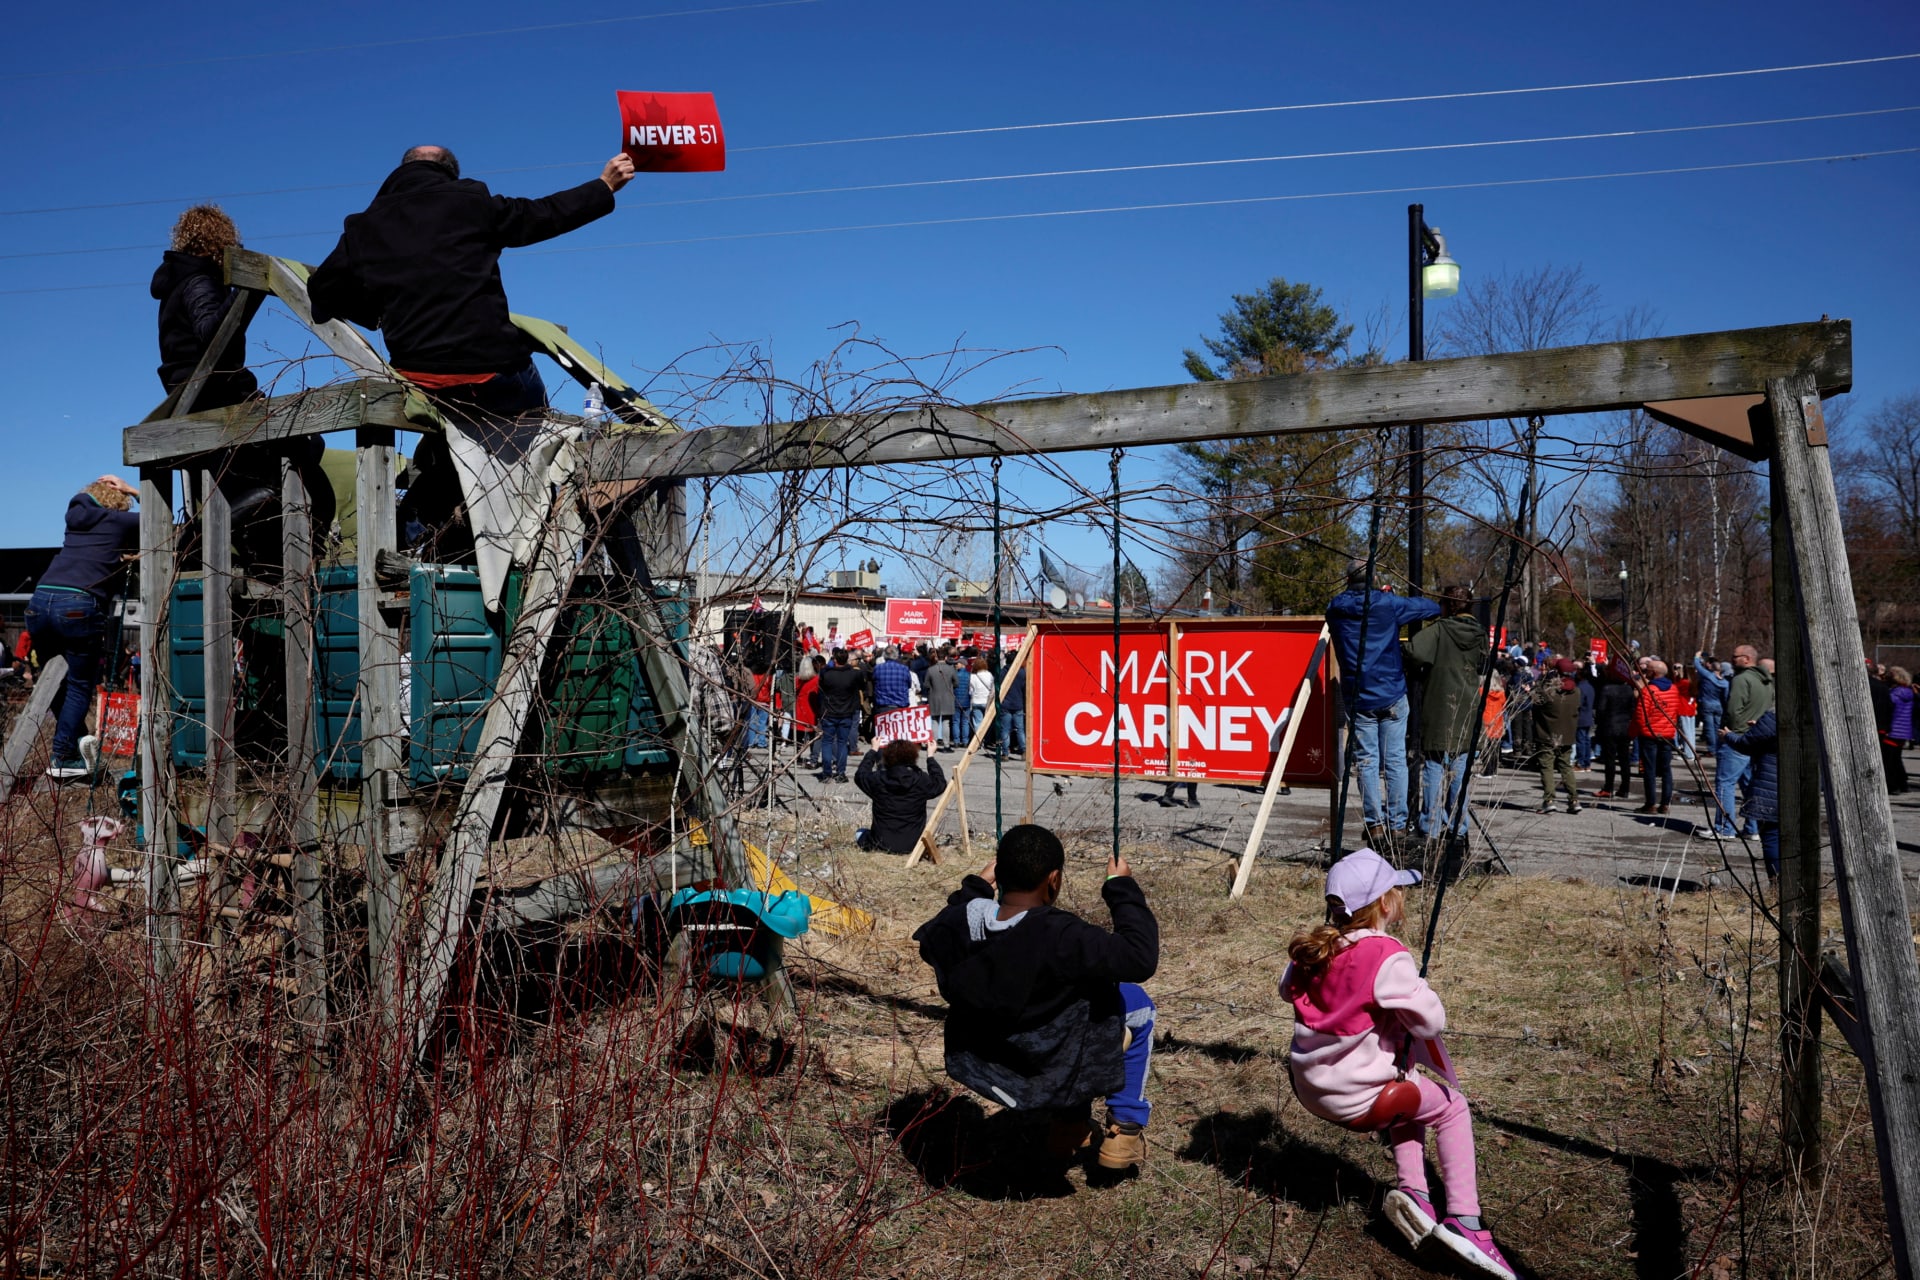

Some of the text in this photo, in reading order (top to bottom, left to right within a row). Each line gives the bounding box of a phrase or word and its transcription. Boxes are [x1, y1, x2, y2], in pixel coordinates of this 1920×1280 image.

[629, 124, 718, 145] NEVER 51
[1100, 650, 1255, 697] MARK
[1064, 701, 1295, 753] CARNEY
[1144, 769, 1155, 777] UN
